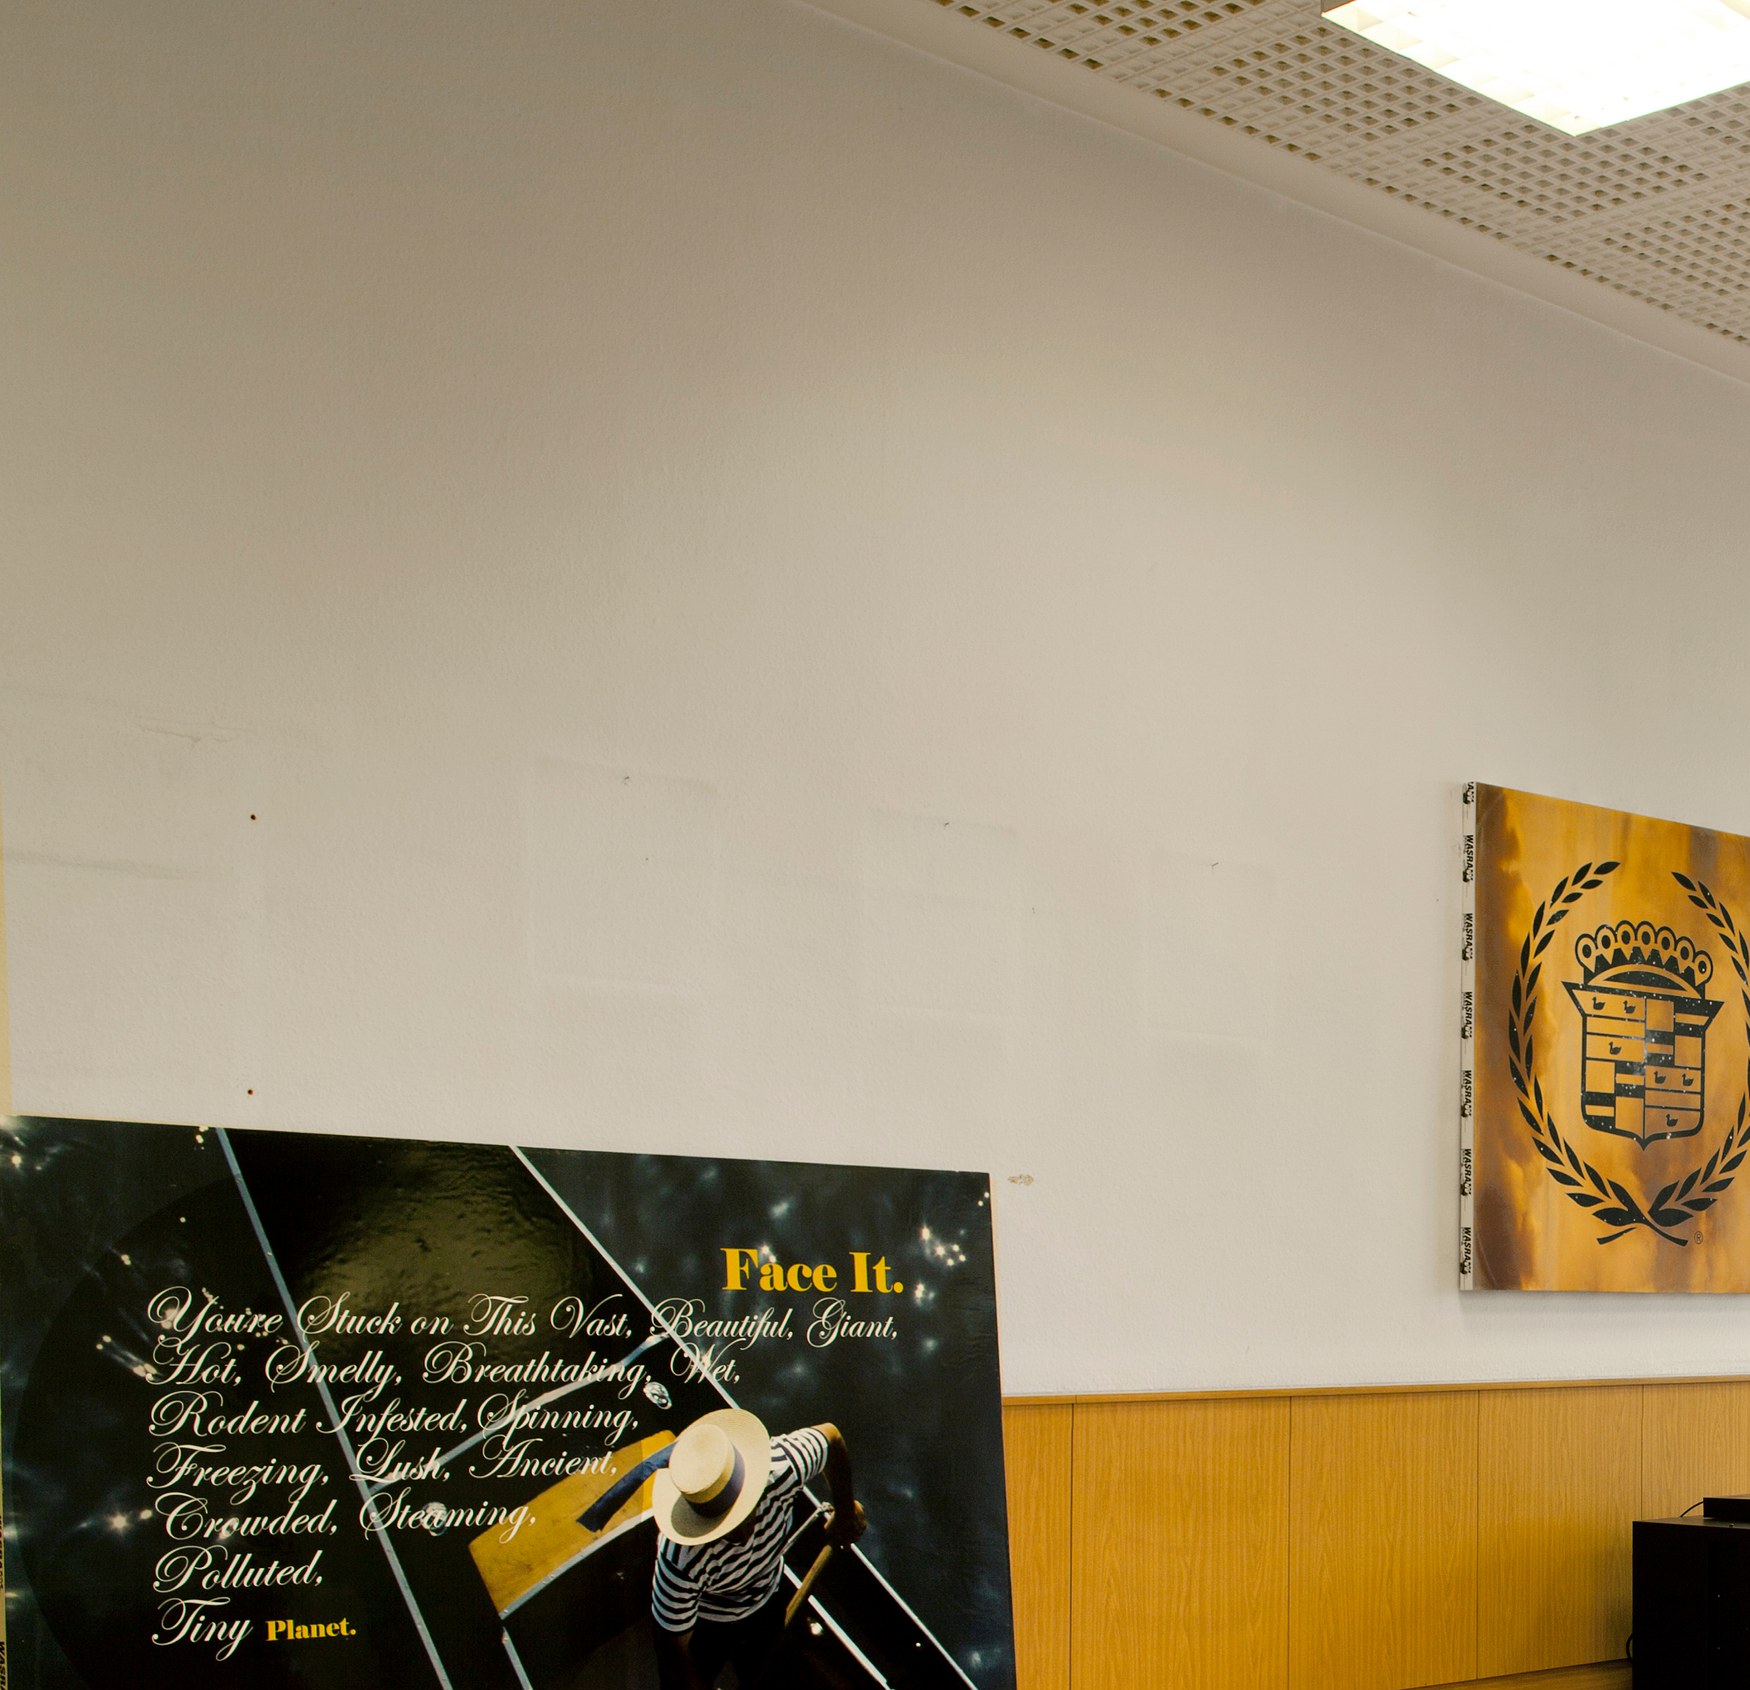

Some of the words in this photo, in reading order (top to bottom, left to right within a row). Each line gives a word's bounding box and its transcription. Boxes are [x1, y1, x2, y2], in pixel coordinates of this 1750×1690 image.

[720, 1248, 838, 1293] Face
[849, 1251, 904, 1294] It.
[296, 1291, 402, 1342] Stuck
[410, 1312, 454, 1336] on
[463, 1293, 537, 1337] This
[550, 1294, 633, 1339] Vast,
[650, 1297, 793, 1350] Beautiful,
[806, 1297, 899, 1348] Giant,
[145, 1339, 242, 1386] Hot,
[265, 1340, 402, 1401] Smelly,
[423, 1341, 652, 1400] Breathtaking,
[670, 1338, 747, 1385] Wet,
[149, 1390, 308, 1437] Rodent
[315, 1393, 468, 1447] Infested,
[476, 1388, 639, 1452] Spinning,
[146, 1441, 331, 1506] Freezing,
[349, 1437, 452, 1484] Lush,
[468, 1434, 618, 1479] Ancient,
[155, 1492, 339, 1541] Crowded,
[358, 1487, 537, 1544] Steaming,
[152, 1545, 324, 1593] Polluted,
[151, 1596, 254, 1662] Tiny
[265, 1617, 357, 1642] Planet.
